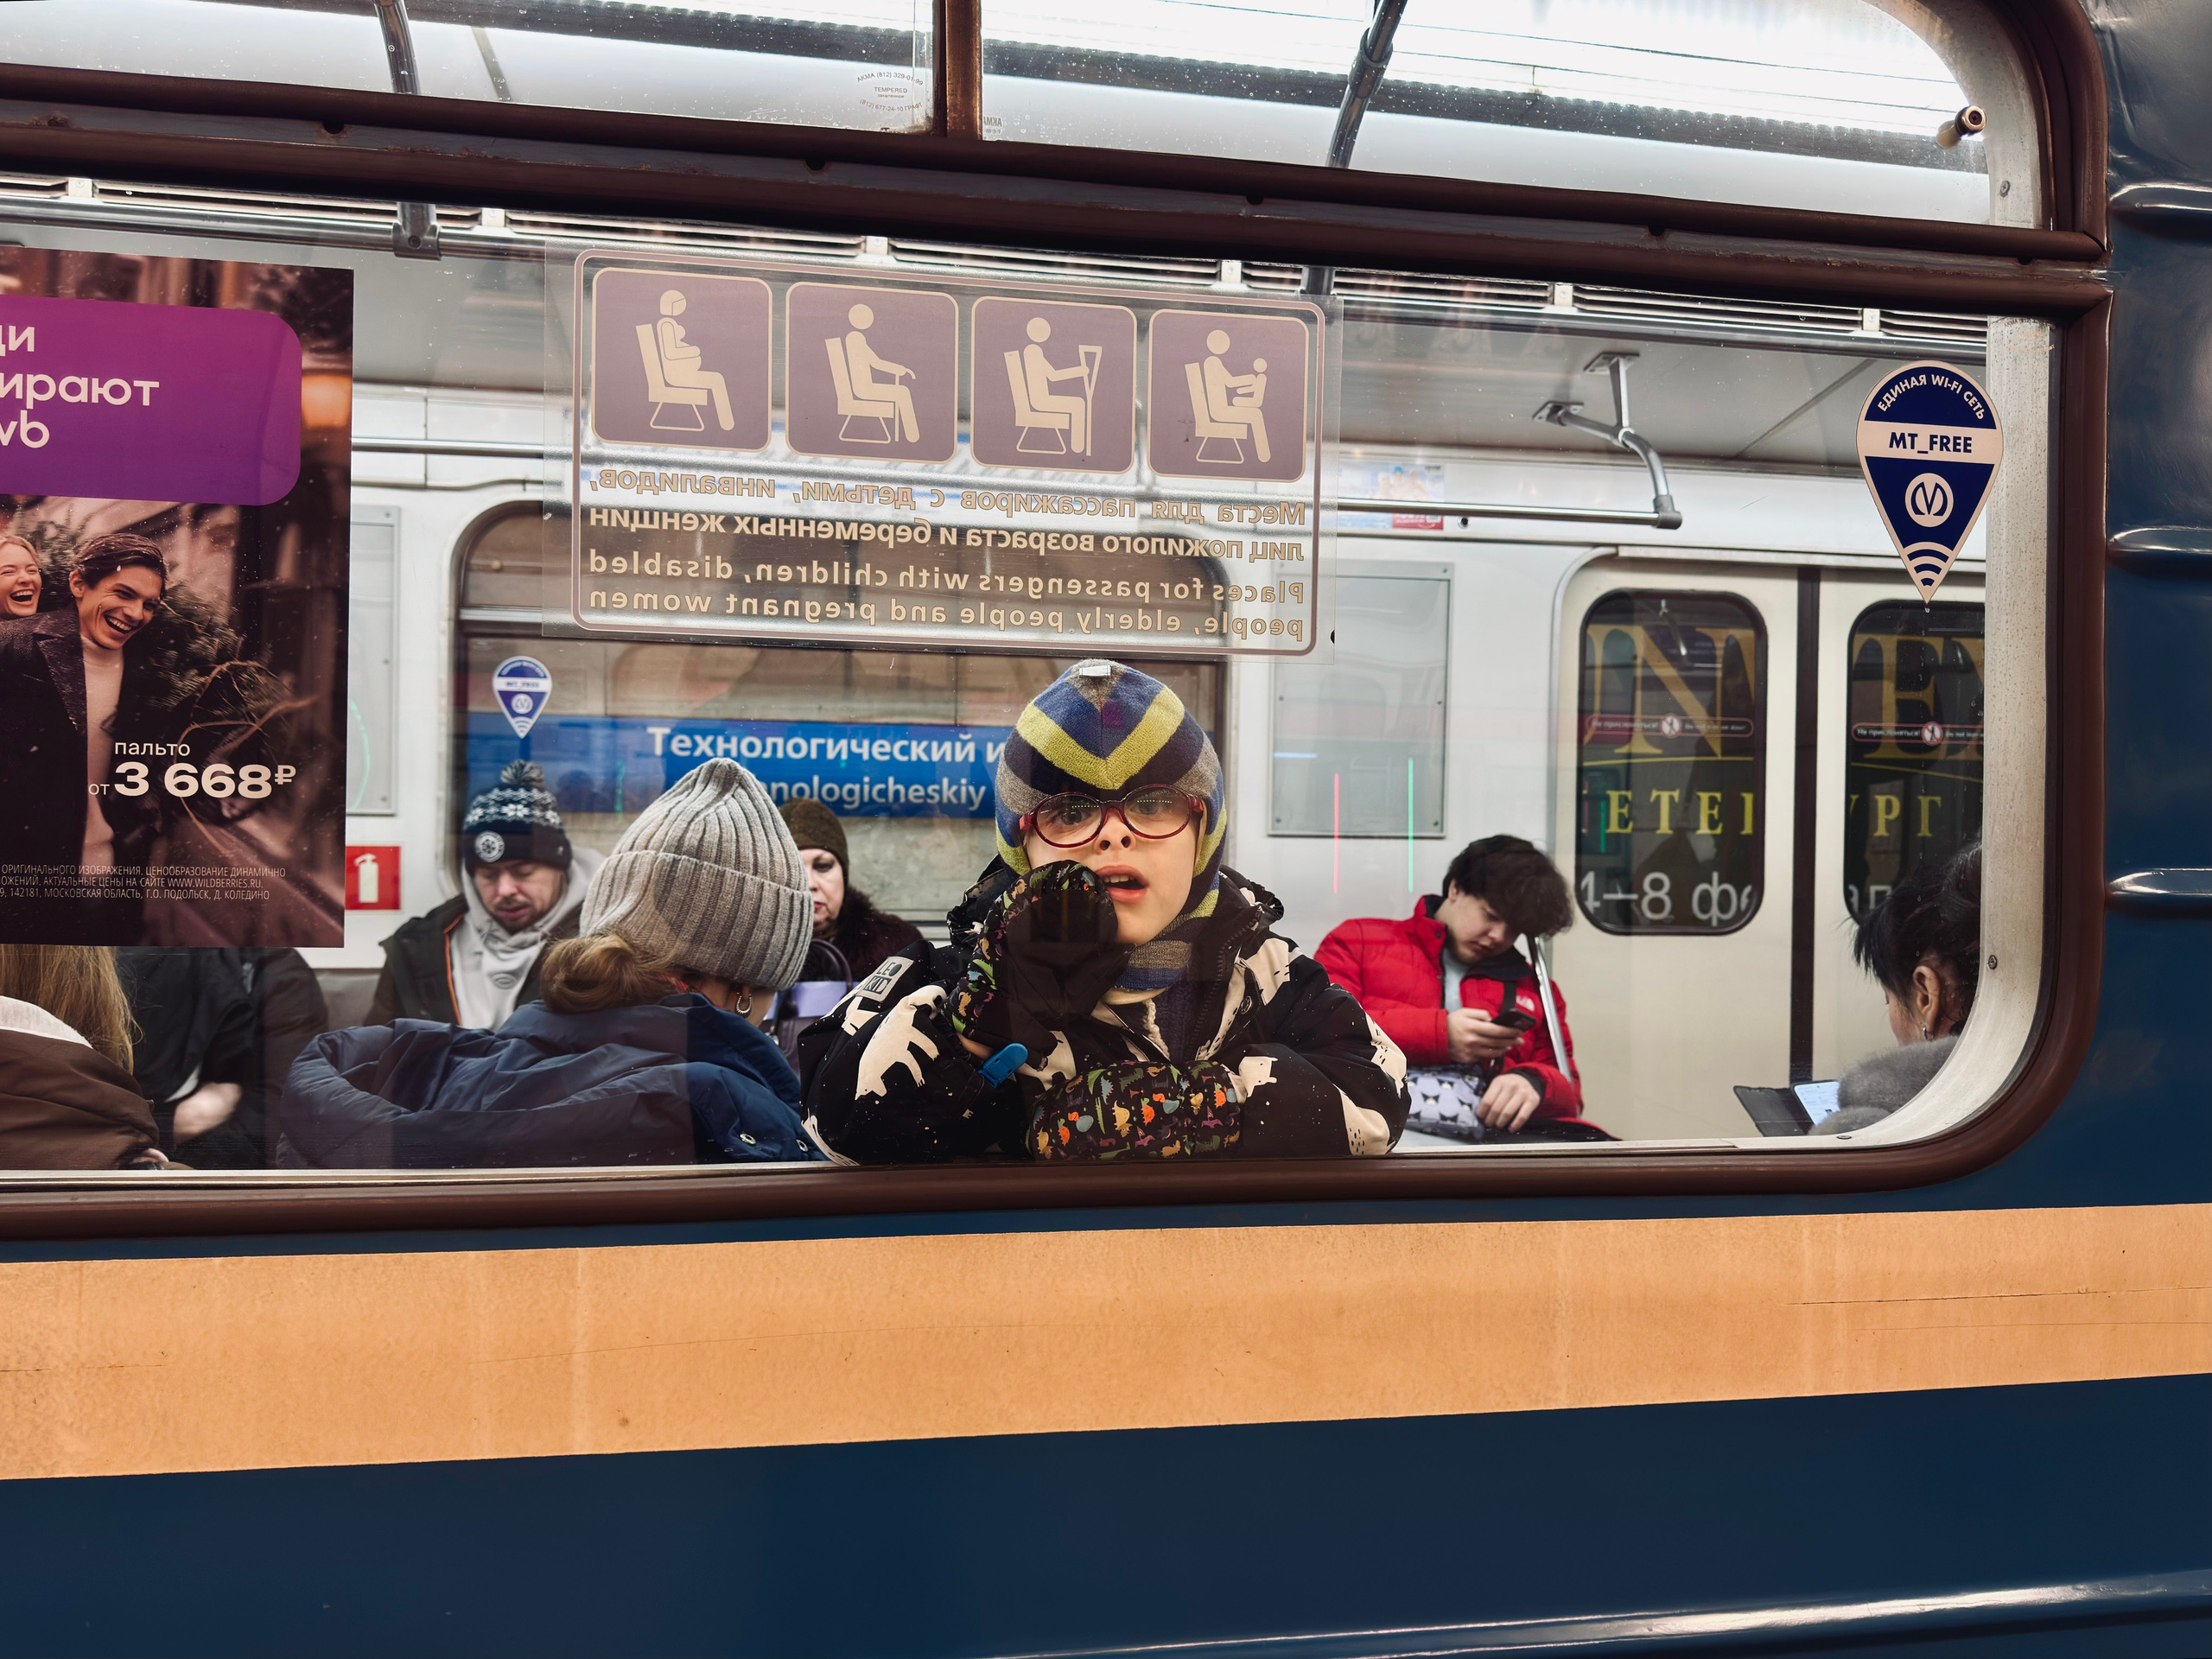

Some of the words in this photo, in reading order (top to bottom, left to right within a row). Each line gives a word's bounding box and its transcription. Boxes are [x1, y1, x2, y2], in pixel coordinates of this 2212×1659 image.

[1878, 374, 1927, 412] ЕДИНАЯ
[1931, 374, 1962, 394] WI-FI
[1963, 391, 1985, 420] СЕТЬ
[1889, 432, 1973, 454] MT_FREE
[114, 742, 191, 757] пальто
[646, 726, 976, 763] Технологический
[88, 784, 111, 795] от
[761, 774, 987, 811] nologicheskiy
[2, 864, 76, 874] ОРИГИНАЛЬНОГО
[79, 865, 143, 875] ИЗОБРАЖЕНИЯ.
[145, 866, 228, 877] ЦЕНООБРАЗОВАНИЕ
[230, 867, 286, 878] ДИНАМИЧНО
[43, 876, 96, 887] АКТУАЛЬНЫЕ
[99, 877, 124, 888] ЦЕНЫ
[125, 877, 137, 887] НА
[139, 875, 165, 887] САЙТЕ
[168, 878, 264, 888] WWW.WILDBERRIES.RU.
[10, 887, 42, 899] 142181,
[44, 888, 101, 899] МОСКОВСКАЯ
[104, 888, 143, 899] ОБЛАСТЬ,
[164, 889, 212, 900] ПОДОЛЬСК,
[225, 890, 270, 900] КОЛЕДИНО
[876, 961, 903, 976] LEO
